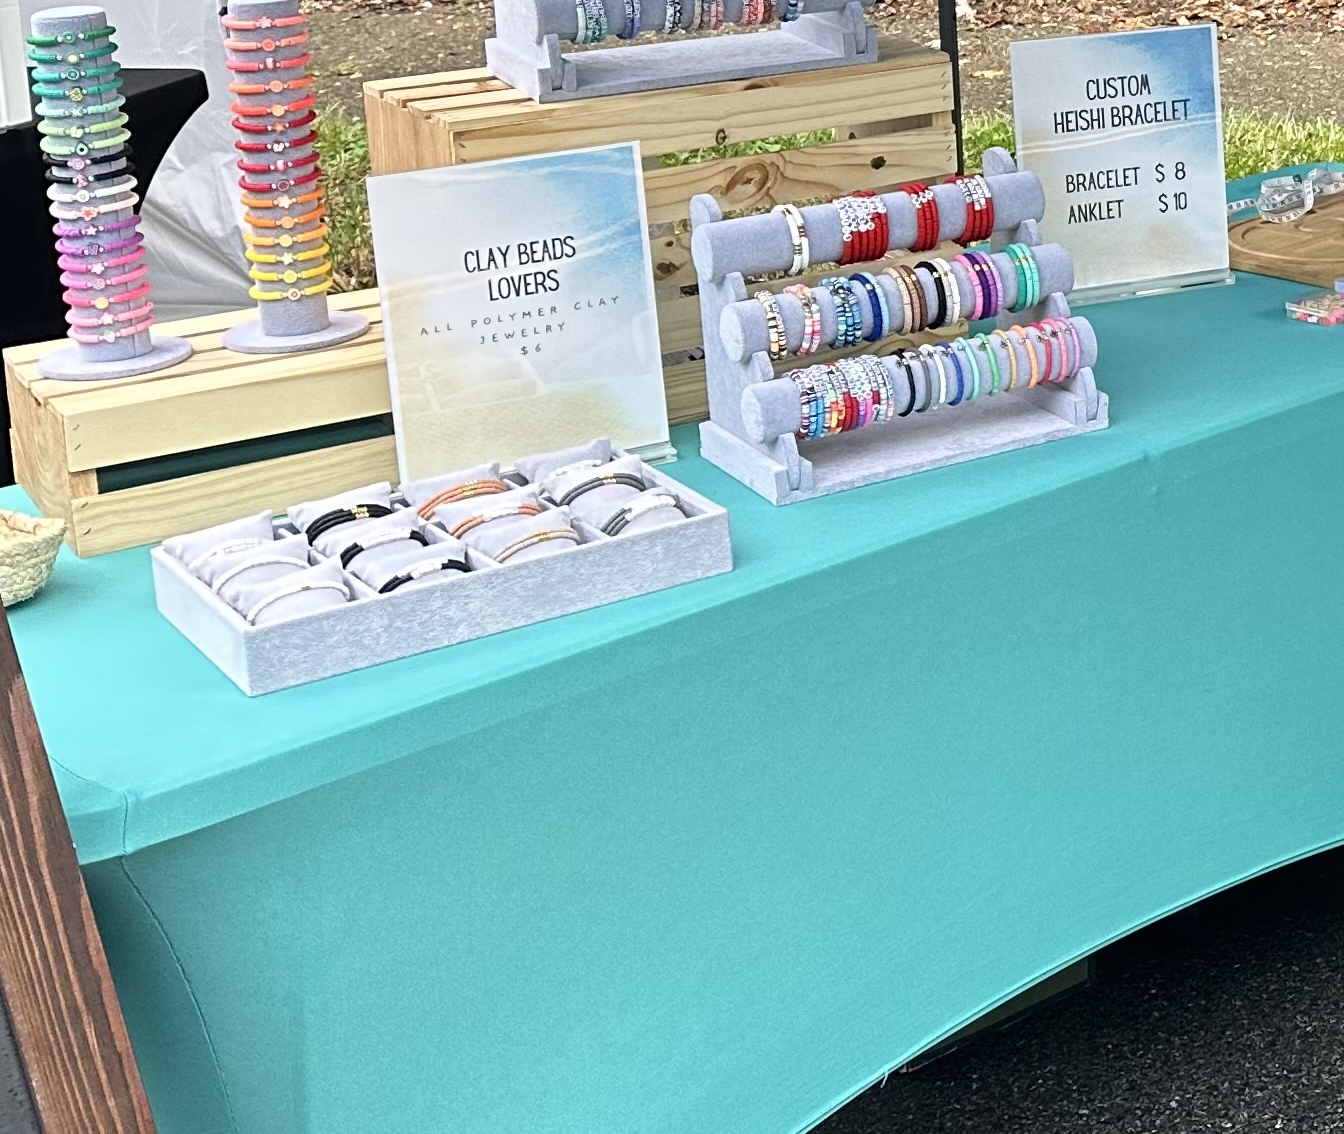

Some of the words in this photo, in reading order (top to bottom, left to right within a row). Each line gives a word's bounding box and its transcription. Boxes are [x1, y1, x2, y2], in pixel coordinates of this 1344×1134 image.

[1086, 73, 1151, 101] CUSTOM
[1053, 106, 1106, 134] HEISHI
[1111, 98, 1190, 128] BRACELET
[1066, 166, 1140, 193] BRACELET
[1068, 199, 1124, 225] ANKLET
[1173, 191, 1188, 211] 10
[463, 244, 510, 274] CLAY
[517, 235, 577, 266] BEADS
[487, 269, 560, 302] LOVERS
[420, 323, 454, 337] ALL
[471, 305, 558, 329] POLYMER
[574, 295, 620, 311] CLAY
[480, 321, 566, 344] JEWELRY
